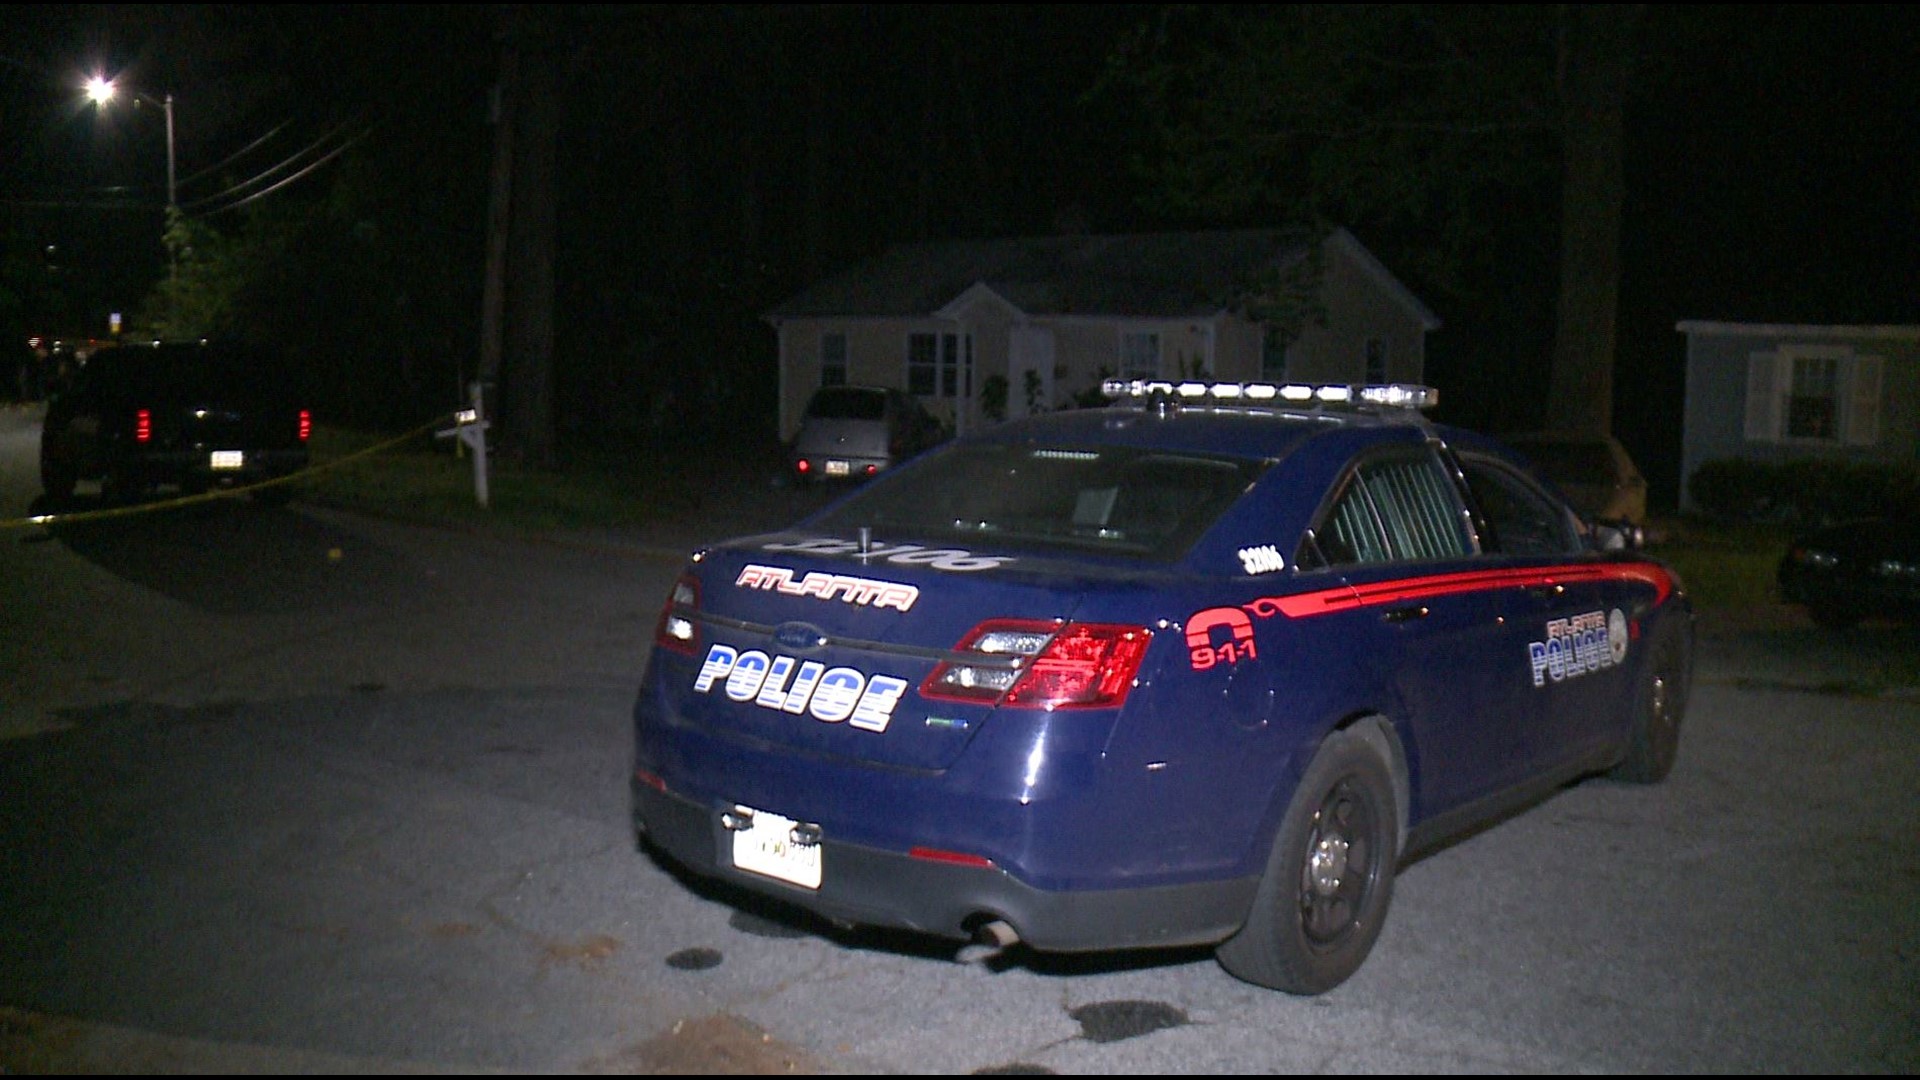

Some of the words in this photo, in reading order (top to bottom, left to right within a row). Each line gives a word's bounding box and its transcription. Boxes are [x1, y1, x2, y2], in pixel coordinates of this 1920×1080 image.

[735, 564, 919, 612] ATLANTA
[1546, 611, 1605, 638] ATLANTA
[1191, 638, 1256, 670] 9-1-1
[1529, 627, 1613, 687] POLICE
[694, 644, 908, 733] POLICE
